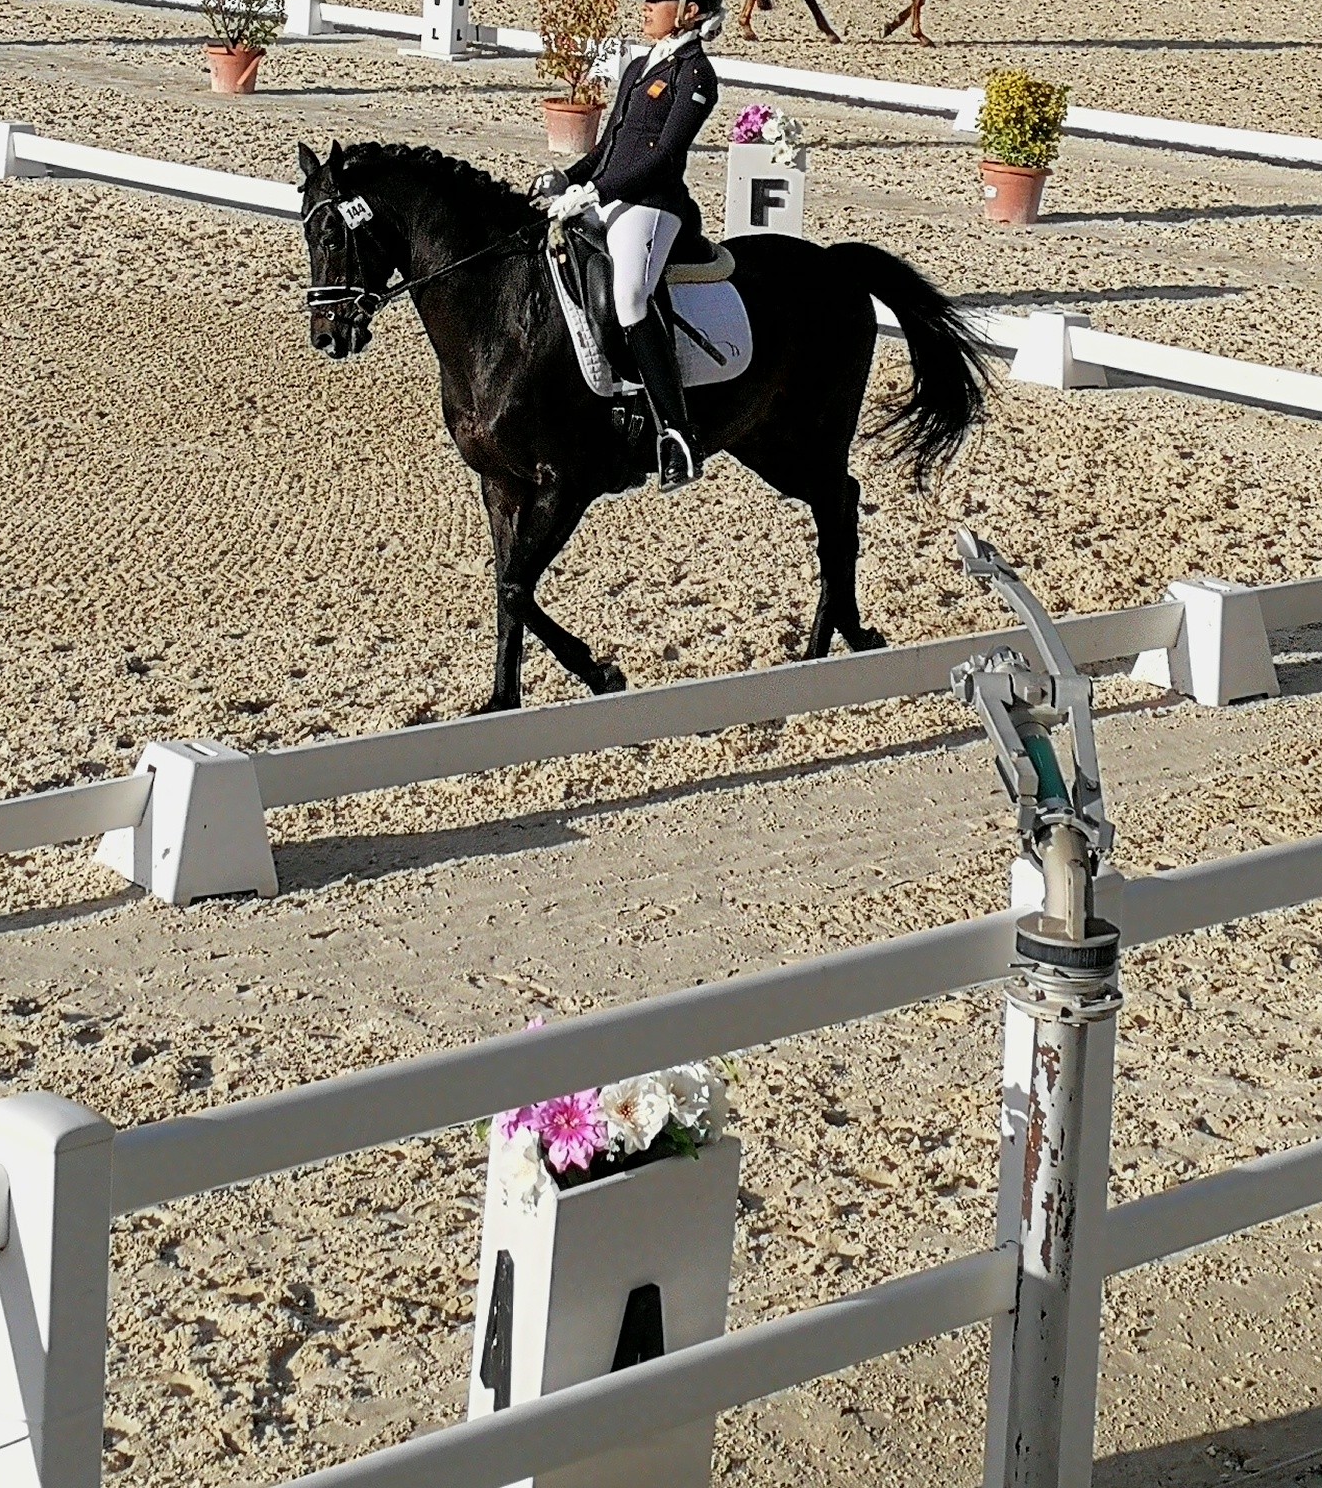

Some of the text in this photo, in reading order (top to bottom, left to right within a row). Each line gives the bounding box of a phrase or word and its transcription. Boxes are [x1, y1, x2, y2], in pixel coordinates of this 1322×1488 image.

[432, 28, 439, 40] L
[346, 203, 367, 220] 144
[750, 178, 790, 228] F
